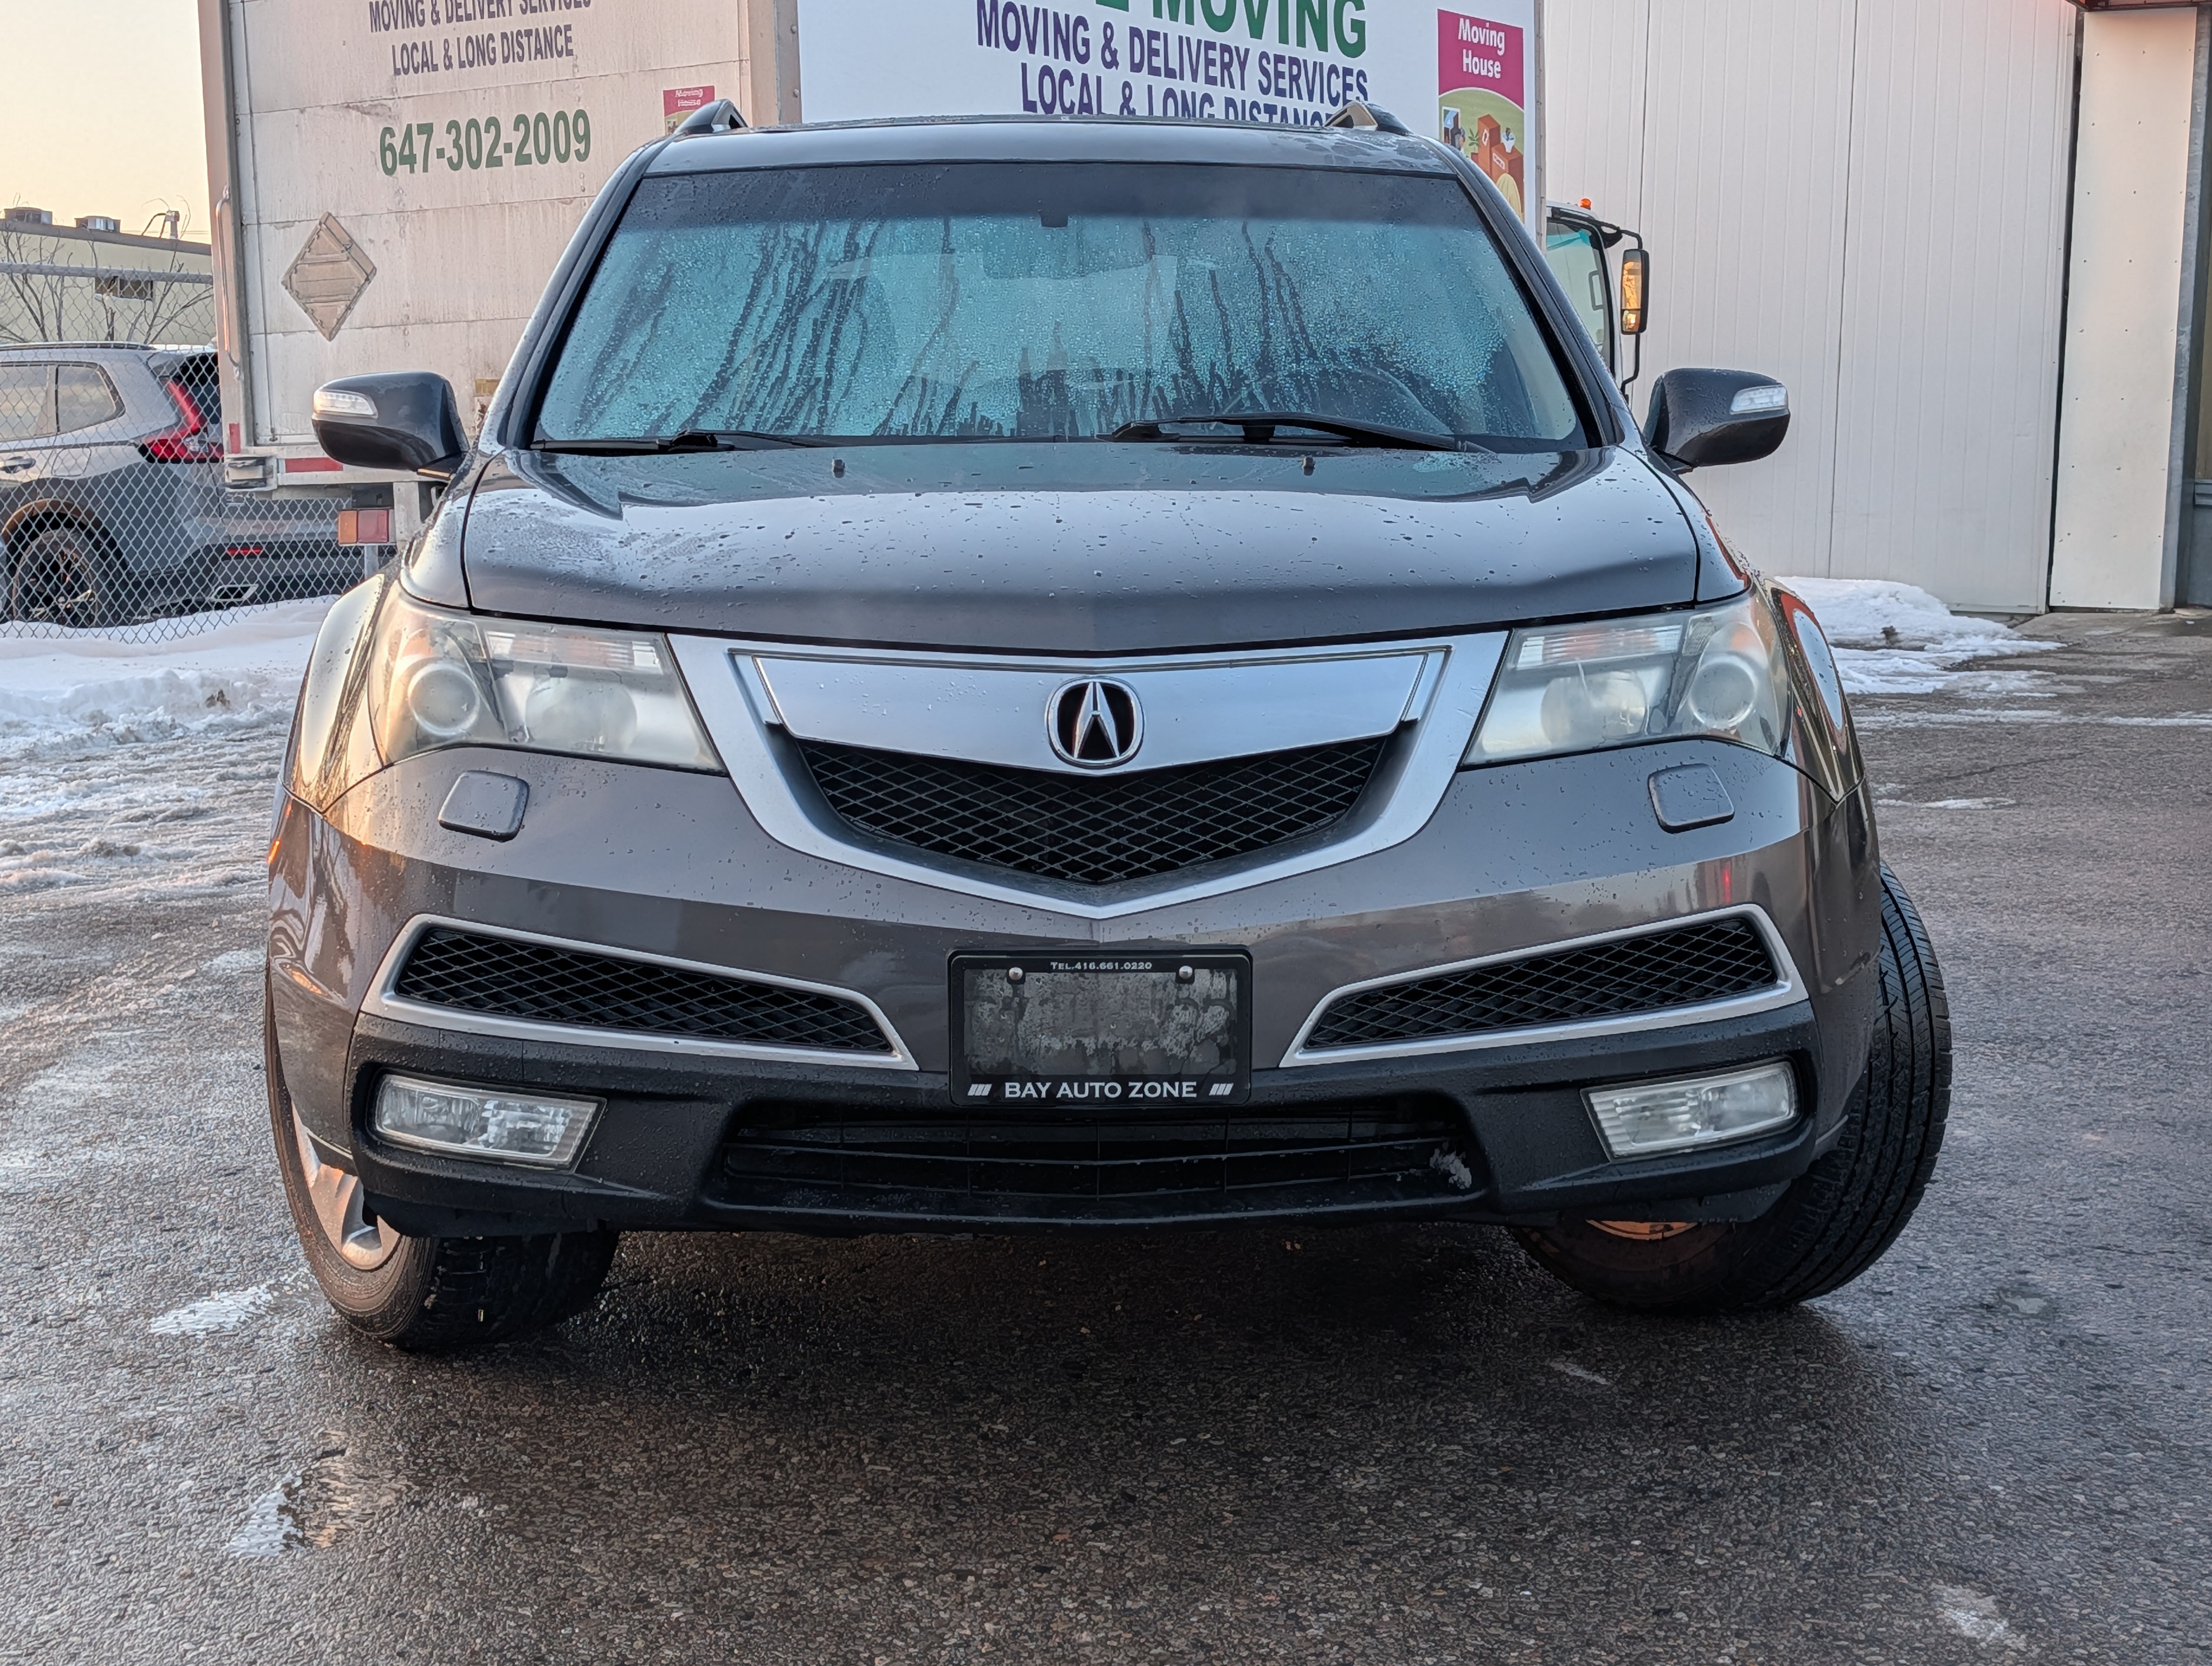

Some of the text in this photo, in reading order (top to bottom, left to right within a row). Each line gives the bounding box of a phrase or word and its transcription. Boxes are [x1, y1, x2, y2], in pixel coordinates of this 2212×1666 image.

[369, 0, 425, 33] MOVING
[431, 0, 441, 25] &
[391, 24, 574, 76] LOCAL & LONG DISTANCE
[976, 0, 1368, 108] MOVING & DELIVERY SERVICES
[1458, 17, 1505, 56] Moving
[1463, 48, 1501, 79] House
[380, 108, 591, 177] 647-302-2009
[1005, 1081, 1197, 1098] BAY AUTO ZONE
